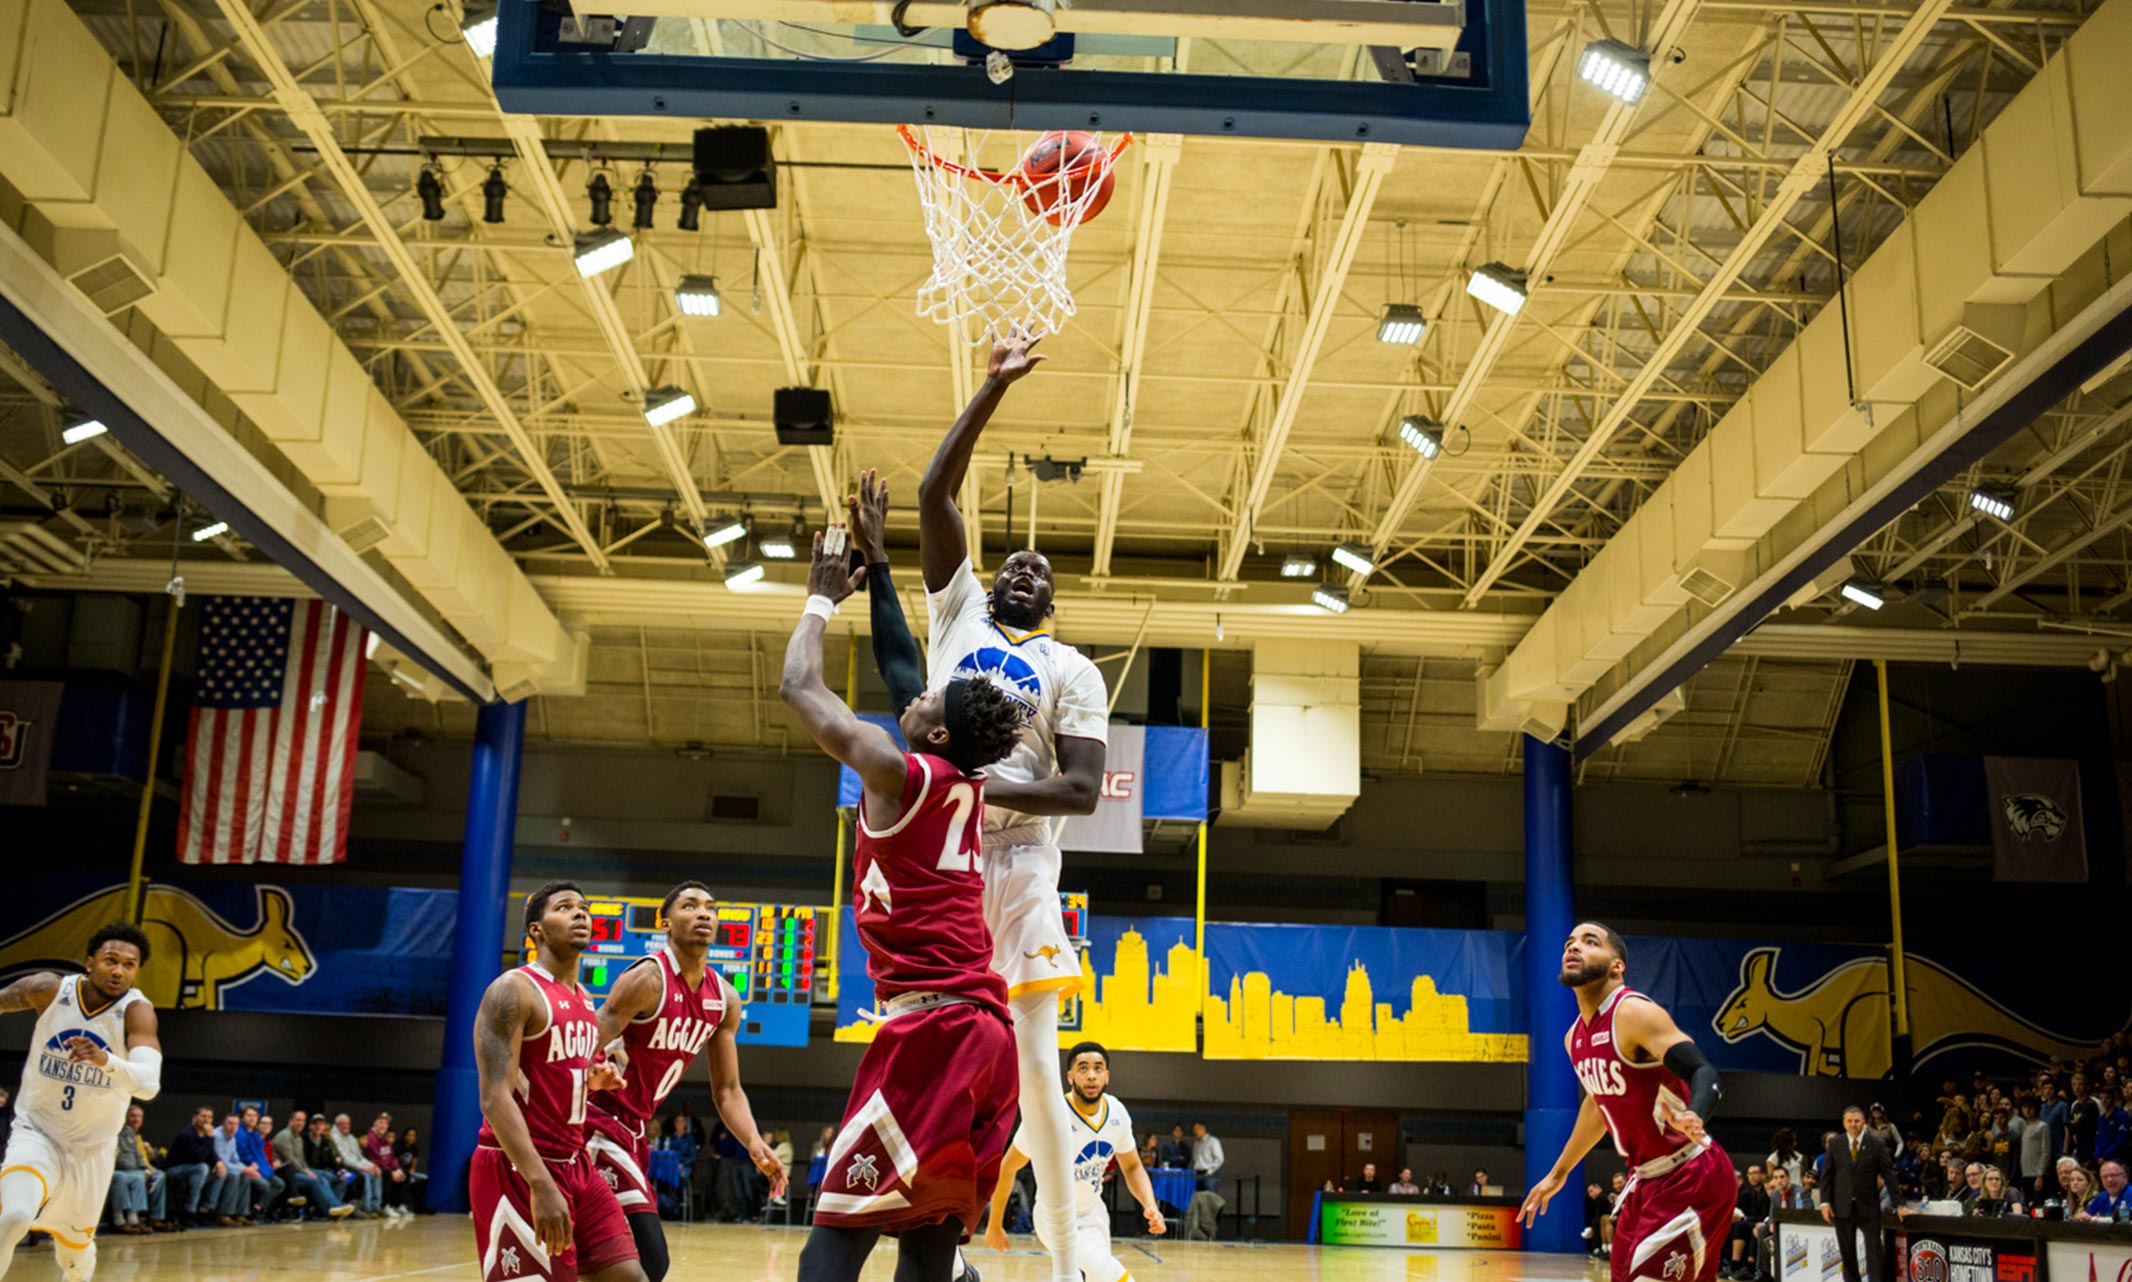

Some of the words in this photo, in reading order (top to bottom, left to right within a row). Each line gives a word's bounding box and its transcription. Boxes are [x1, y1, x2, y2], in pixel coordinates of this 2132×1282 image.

[1067, 893, 1087, 910] 39
[592, 917, 623, 942] 51
[721, 923, 751, 947] 73
[756, 931, 775, 945] 23
[39, 1052, 83, 1082] KANSAS
[653, 1058, 685, 1102] 0
[61, 1085, 75, 1111] 3
[1949, 1245, 1973, 1264] KANSAS
[1916, 1256, 1944, 1282] 810
